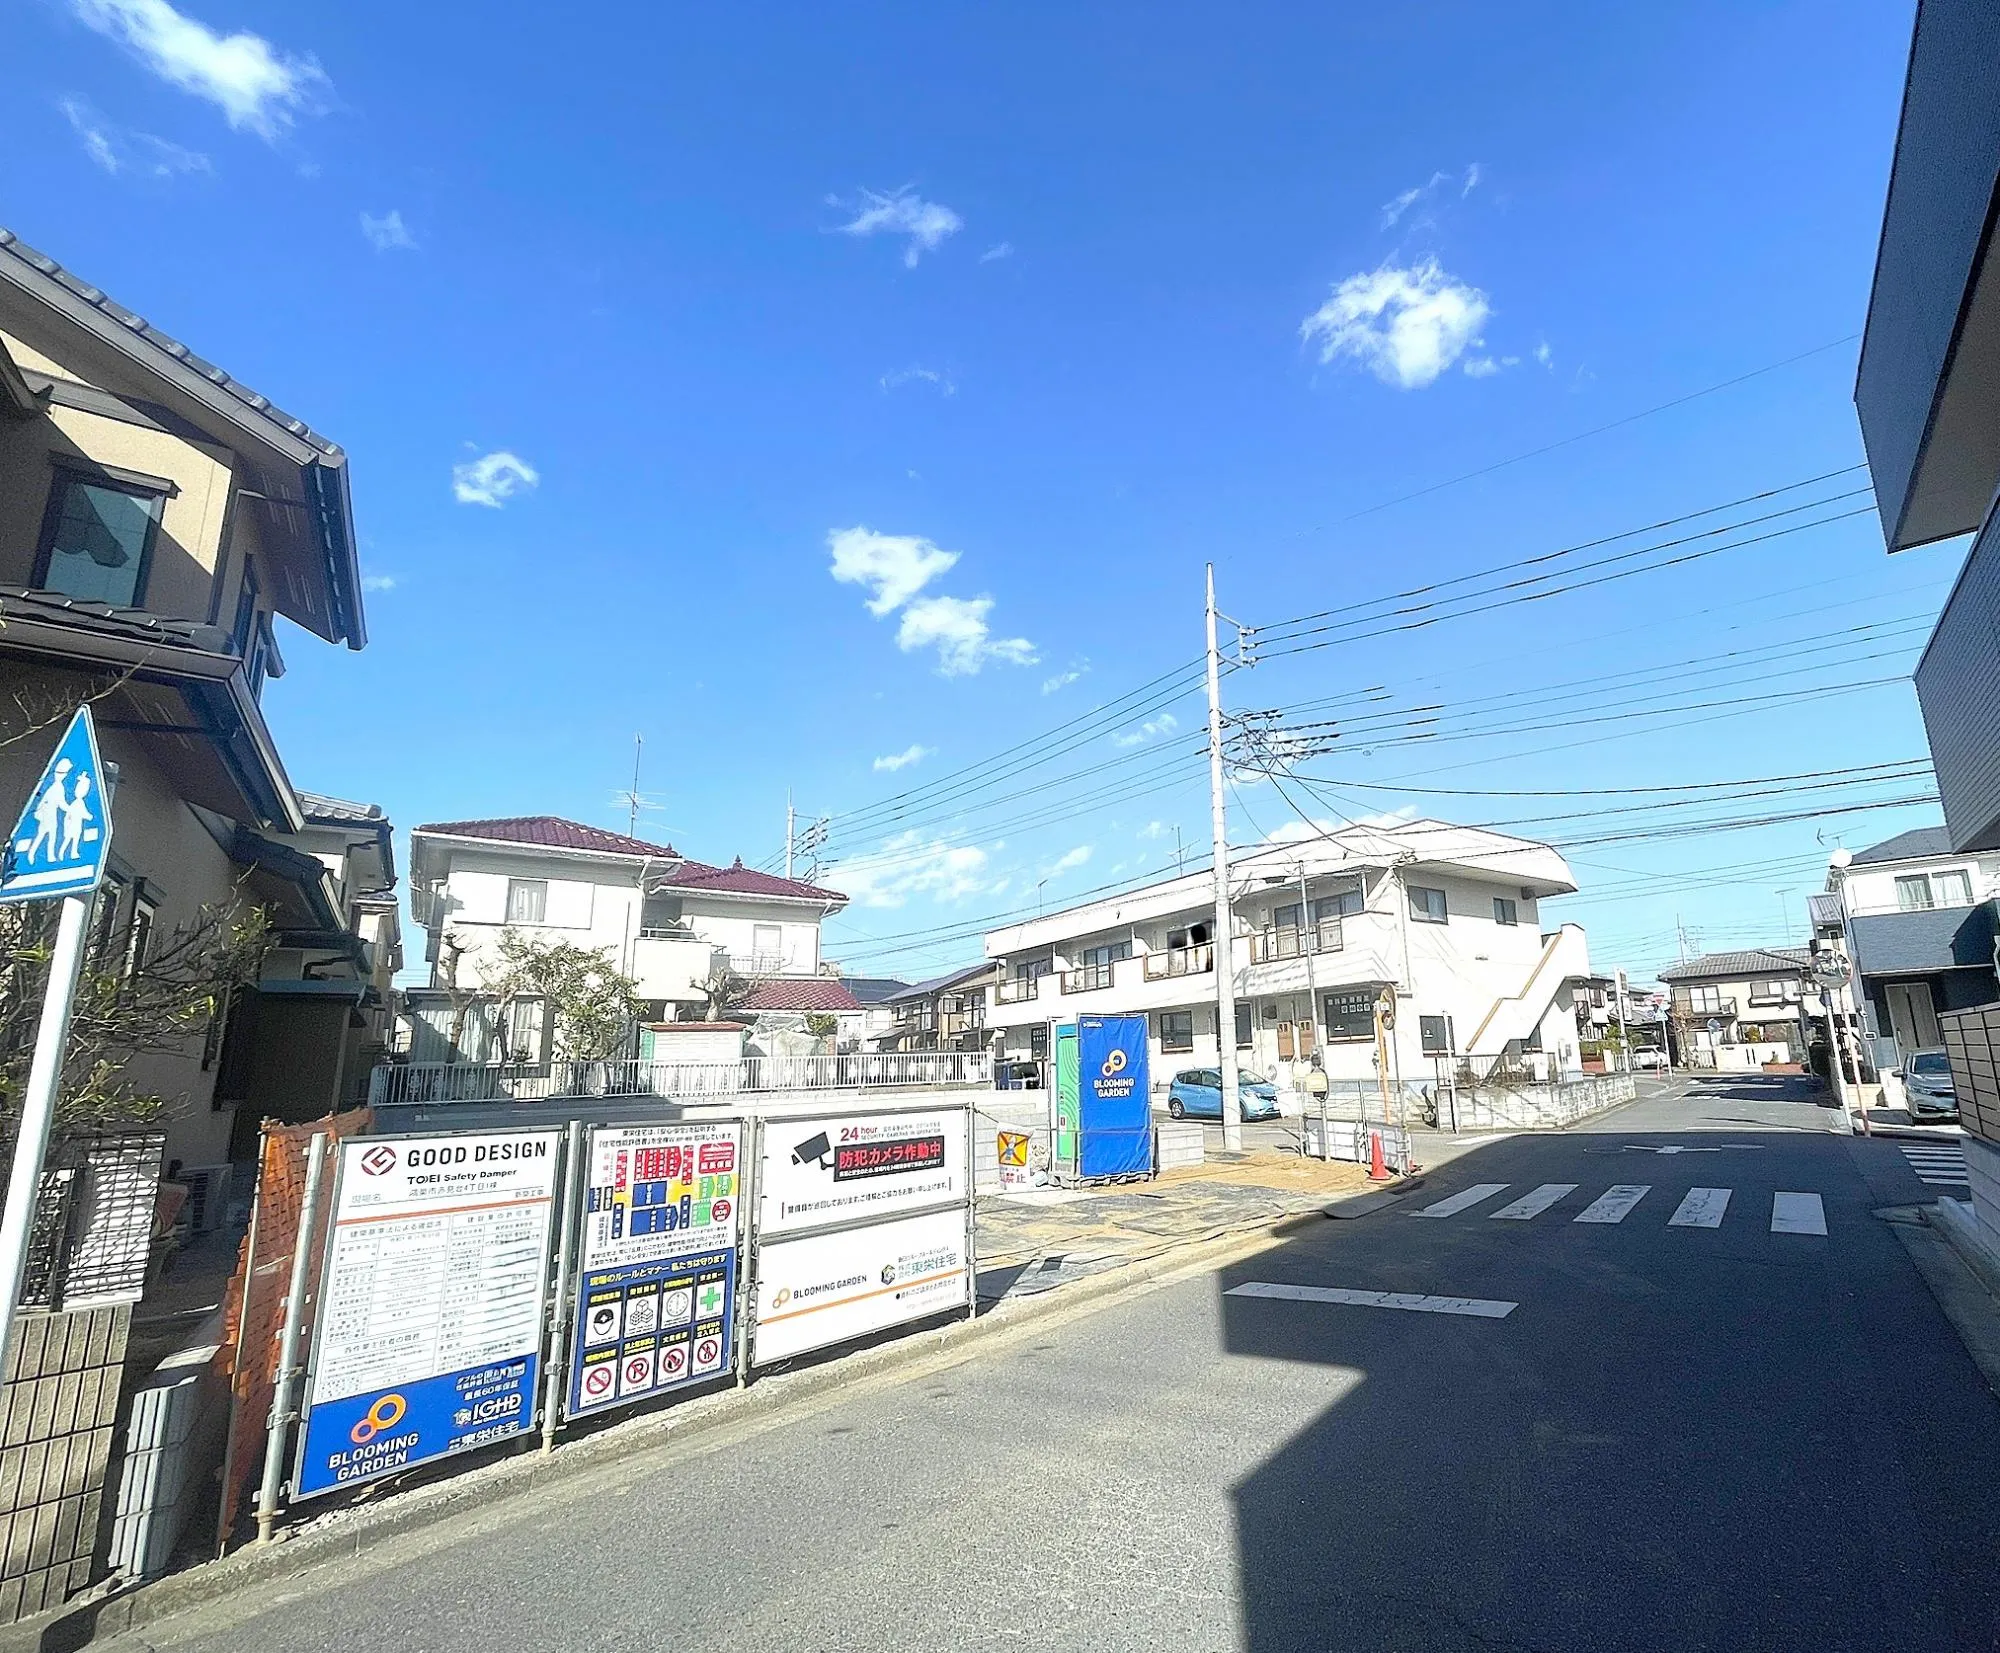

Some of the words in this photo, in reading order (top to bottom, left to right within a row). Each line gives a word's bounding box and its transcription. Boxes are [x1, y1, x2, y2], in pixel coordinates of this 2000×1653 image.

[1093, 1077, 1134, 1089] BLOOMING
[1097, 1086, 1131, 1097] GARDEN
[840, 1126, 859, 1142] 24
[860, 1126, 878, 1135] hour
[407, 1146, 467, 1167] GOOD
[475, 1141, 547, 1162] DESIGN
[839, 1140, 941, 1169] 防犯カメラ作動中
[444, 1172, 477, 1183] Safety
[480, 1169, 518, 1179] Damper
[911, 1252, 957, 1275] 東栄住宅
[793, 1282, 836, 1299] BLOOMING
[836, 1274, 867, 1289] GARDEN
[461, 1419, 520, 1446] 東栄住宅
[328, 1432, 419, 1469] BLOOMING
[336, 1449, 408, 1481] GARDEN
